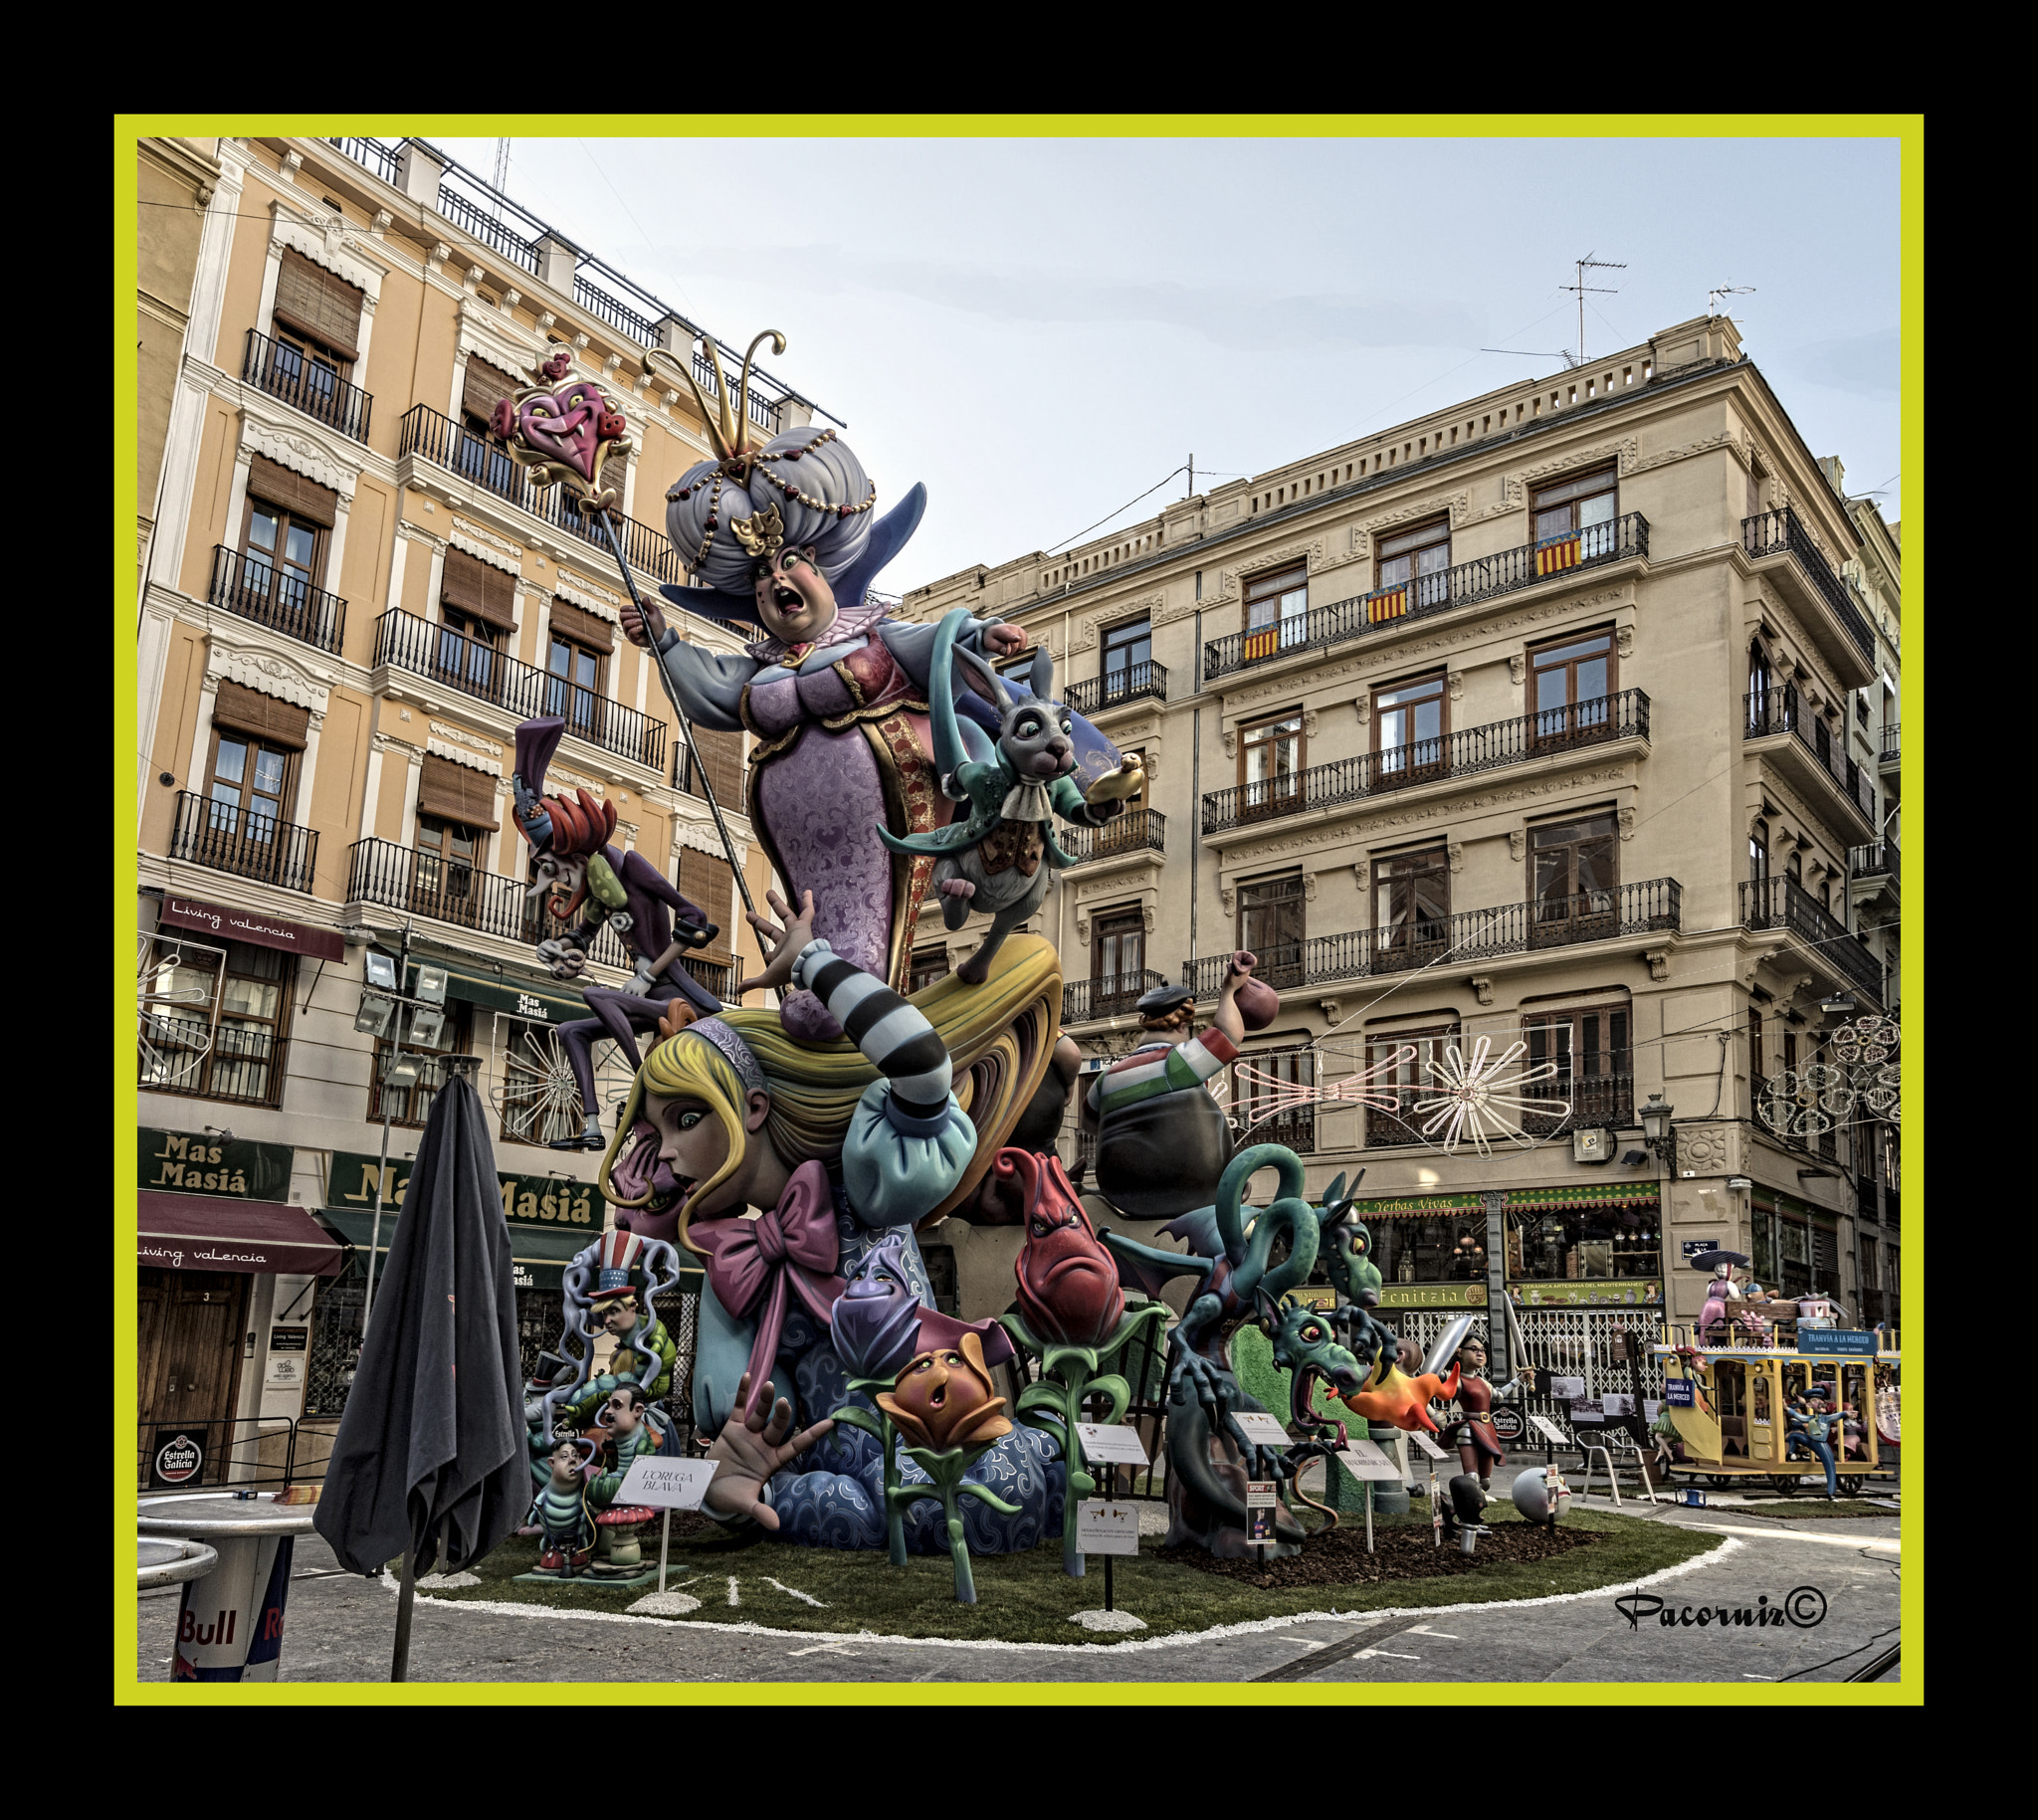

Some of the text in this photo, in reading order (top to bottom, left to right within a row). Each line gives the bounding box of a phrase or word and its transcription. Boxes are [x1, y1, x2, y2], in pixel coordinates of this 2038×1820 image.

[171, 901, 222, 929] Living
[517, 993, 540, 1007] Mas
[516, 1003, 548, 1019] Masiá
[154, 1135, 222, 1164] Mas
[150, 1161, 246, 1193] Masiá
[343, 1163, 412, 1206] Ma
[1374, 1197, 1453, 1212] Yerbas Vivas
[512, 1264, 525, 1276] as
[513, 1274, 533, 1287] asiá
[203, 1293, 210, 1302] 3
[1380, 1289, 1458, 1304] Fenitzia
[1847, 1335, 1870, 1344] MERCED
[555, 1429, 575, 1438] Estrella
[164, 1450, 195, 1460] Estrella
[164, 1459, 193, 1470] Galicia
[643, 1481, 683, 1493] BLAVA
[179, 1609, 237, 1646] Bull
